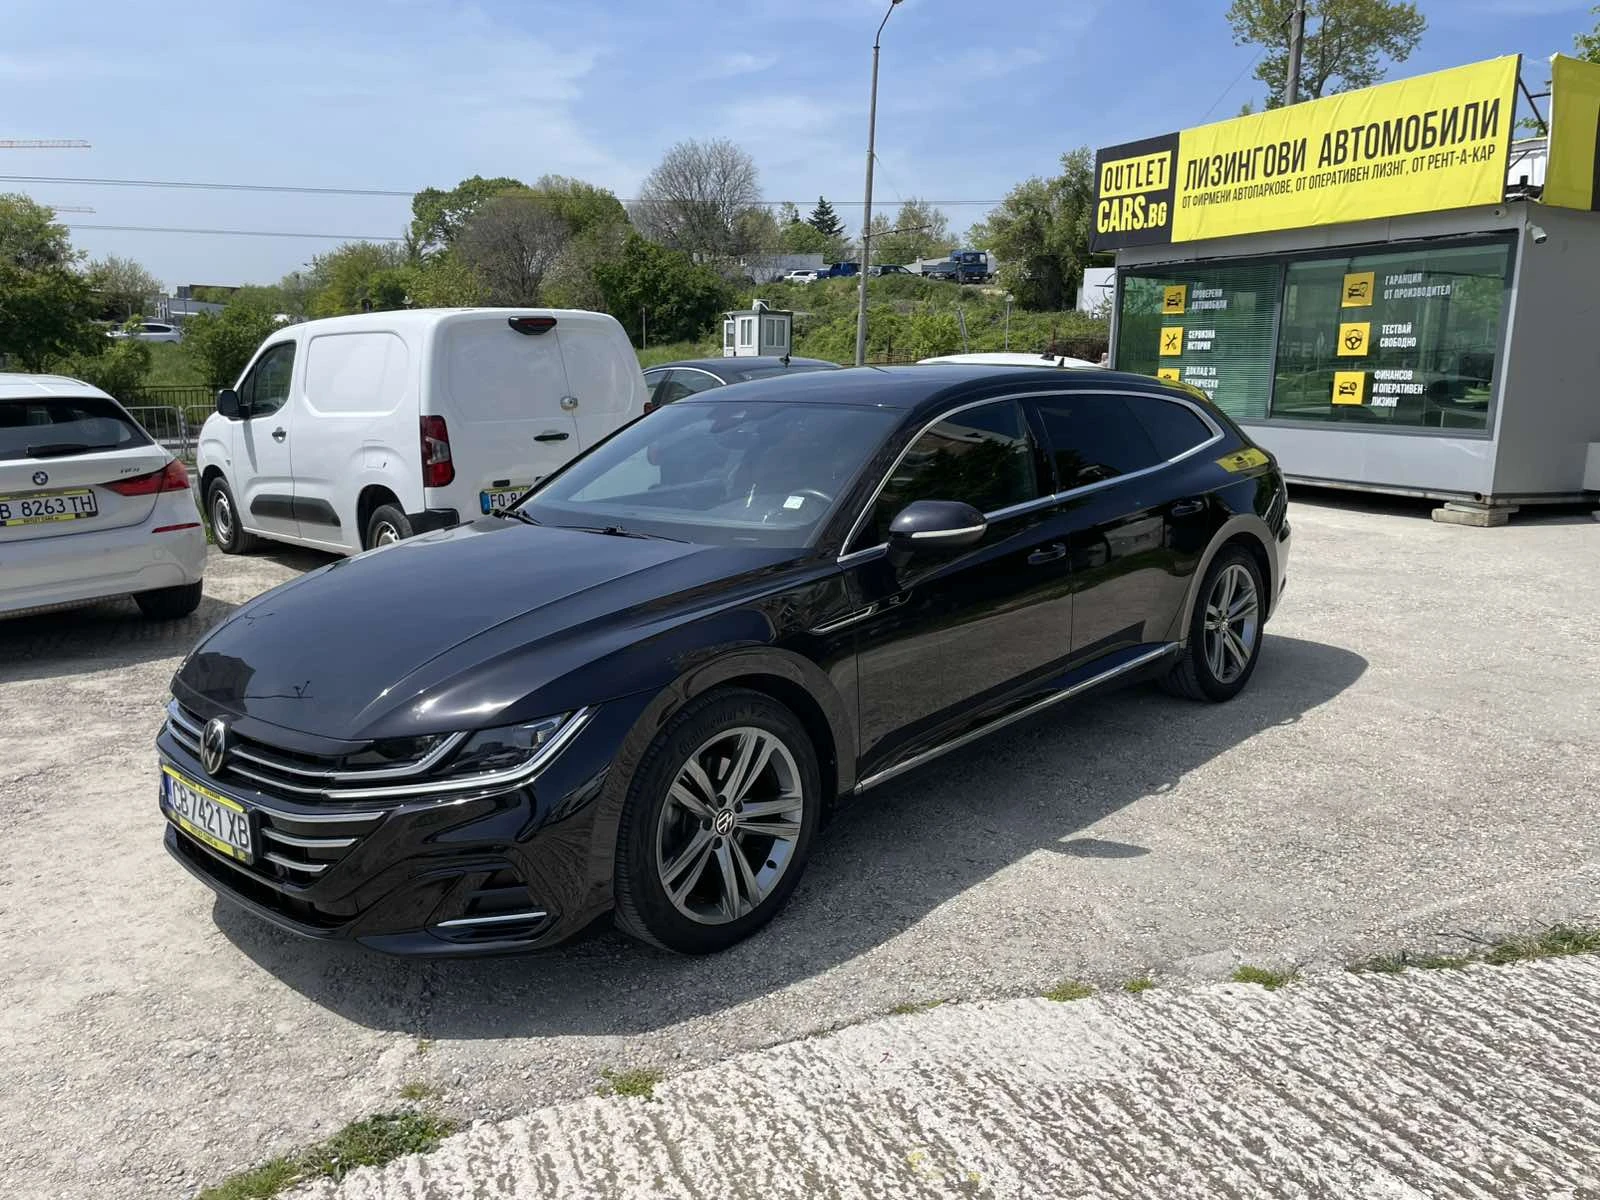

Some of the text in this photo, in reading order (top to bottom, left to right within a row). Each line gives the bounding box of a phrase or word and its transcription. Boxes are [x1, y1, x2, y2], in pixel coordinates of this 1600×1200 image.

[1184, 97, 1501, 192] ЛИЗИНГОВИ АВТОМОБИЛИ
[1104, 157, 1167, 192] OUTLET
[1182, 194, 1192, 209] ОТ
[1192, 188, 1232, 207] ФИРМЕНИ
[1232, 178, 1294, 201] АВТОПАРКОВЕ,
[1295, 175, 1308, 192] ОТ
[1308, 165, 1369, 190] ОПЕРАТИВЕН
[1411, 154, 1426, 173] ОТ
[1427, 143, 1496, 169] РЕНТ-А-КАР
[1097, 194, 1168, 234] CARS.BG
[1383, 289, 1393, 300] ОТ
[1382, 321, 1413, 334] ТЕСТВАЙ
[1379, 336, 1417, 348] СВОБОДНО
[1185, 366, 1217, 376] ДОКЛАД ЗА
[1374, 369, 1413, 381] ФИНАНСОВ
[1379, 383, 1423, 394] ОПЕРАТИВЕН
[1370, 396, 1400, 407] ЛИЗИНГ
[21, 498, 66, 517] 8263
[67, 495, 93, 512] TH
